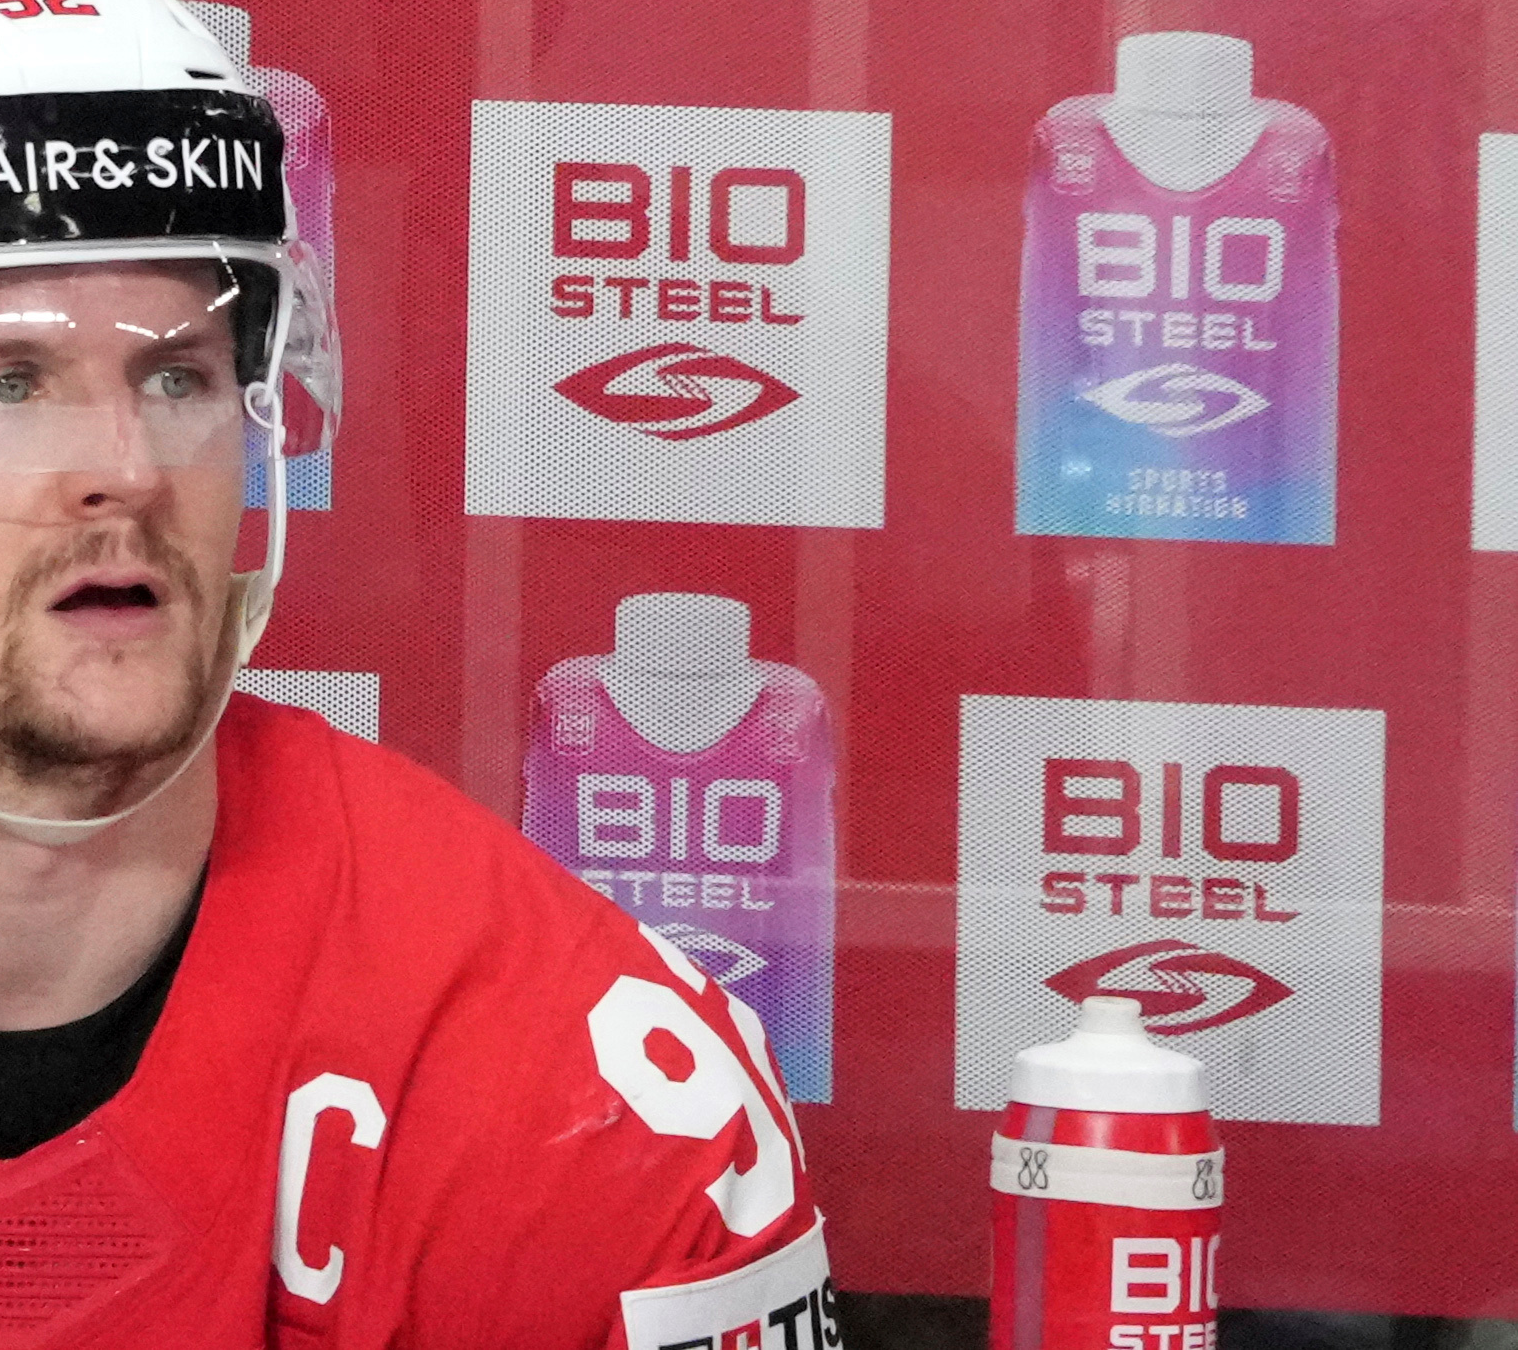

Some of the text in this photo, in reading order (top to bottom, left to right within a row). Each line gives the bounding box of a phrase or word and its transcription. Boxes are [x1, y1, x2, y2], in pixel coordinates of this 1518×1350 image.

[553, 161, 806, 266] BIO
[1076, 212, 1285, 302] BIO
[552, 275, 804, 327] STEEL
[1079, 309, 1276, 350] STEEL
[578, 774, 782, 865] BIO
[1045, 758, 1300, 863] BIO
[1044, 871, 1299, 922] STEEL
[272, 1071, 386, 1304] C
